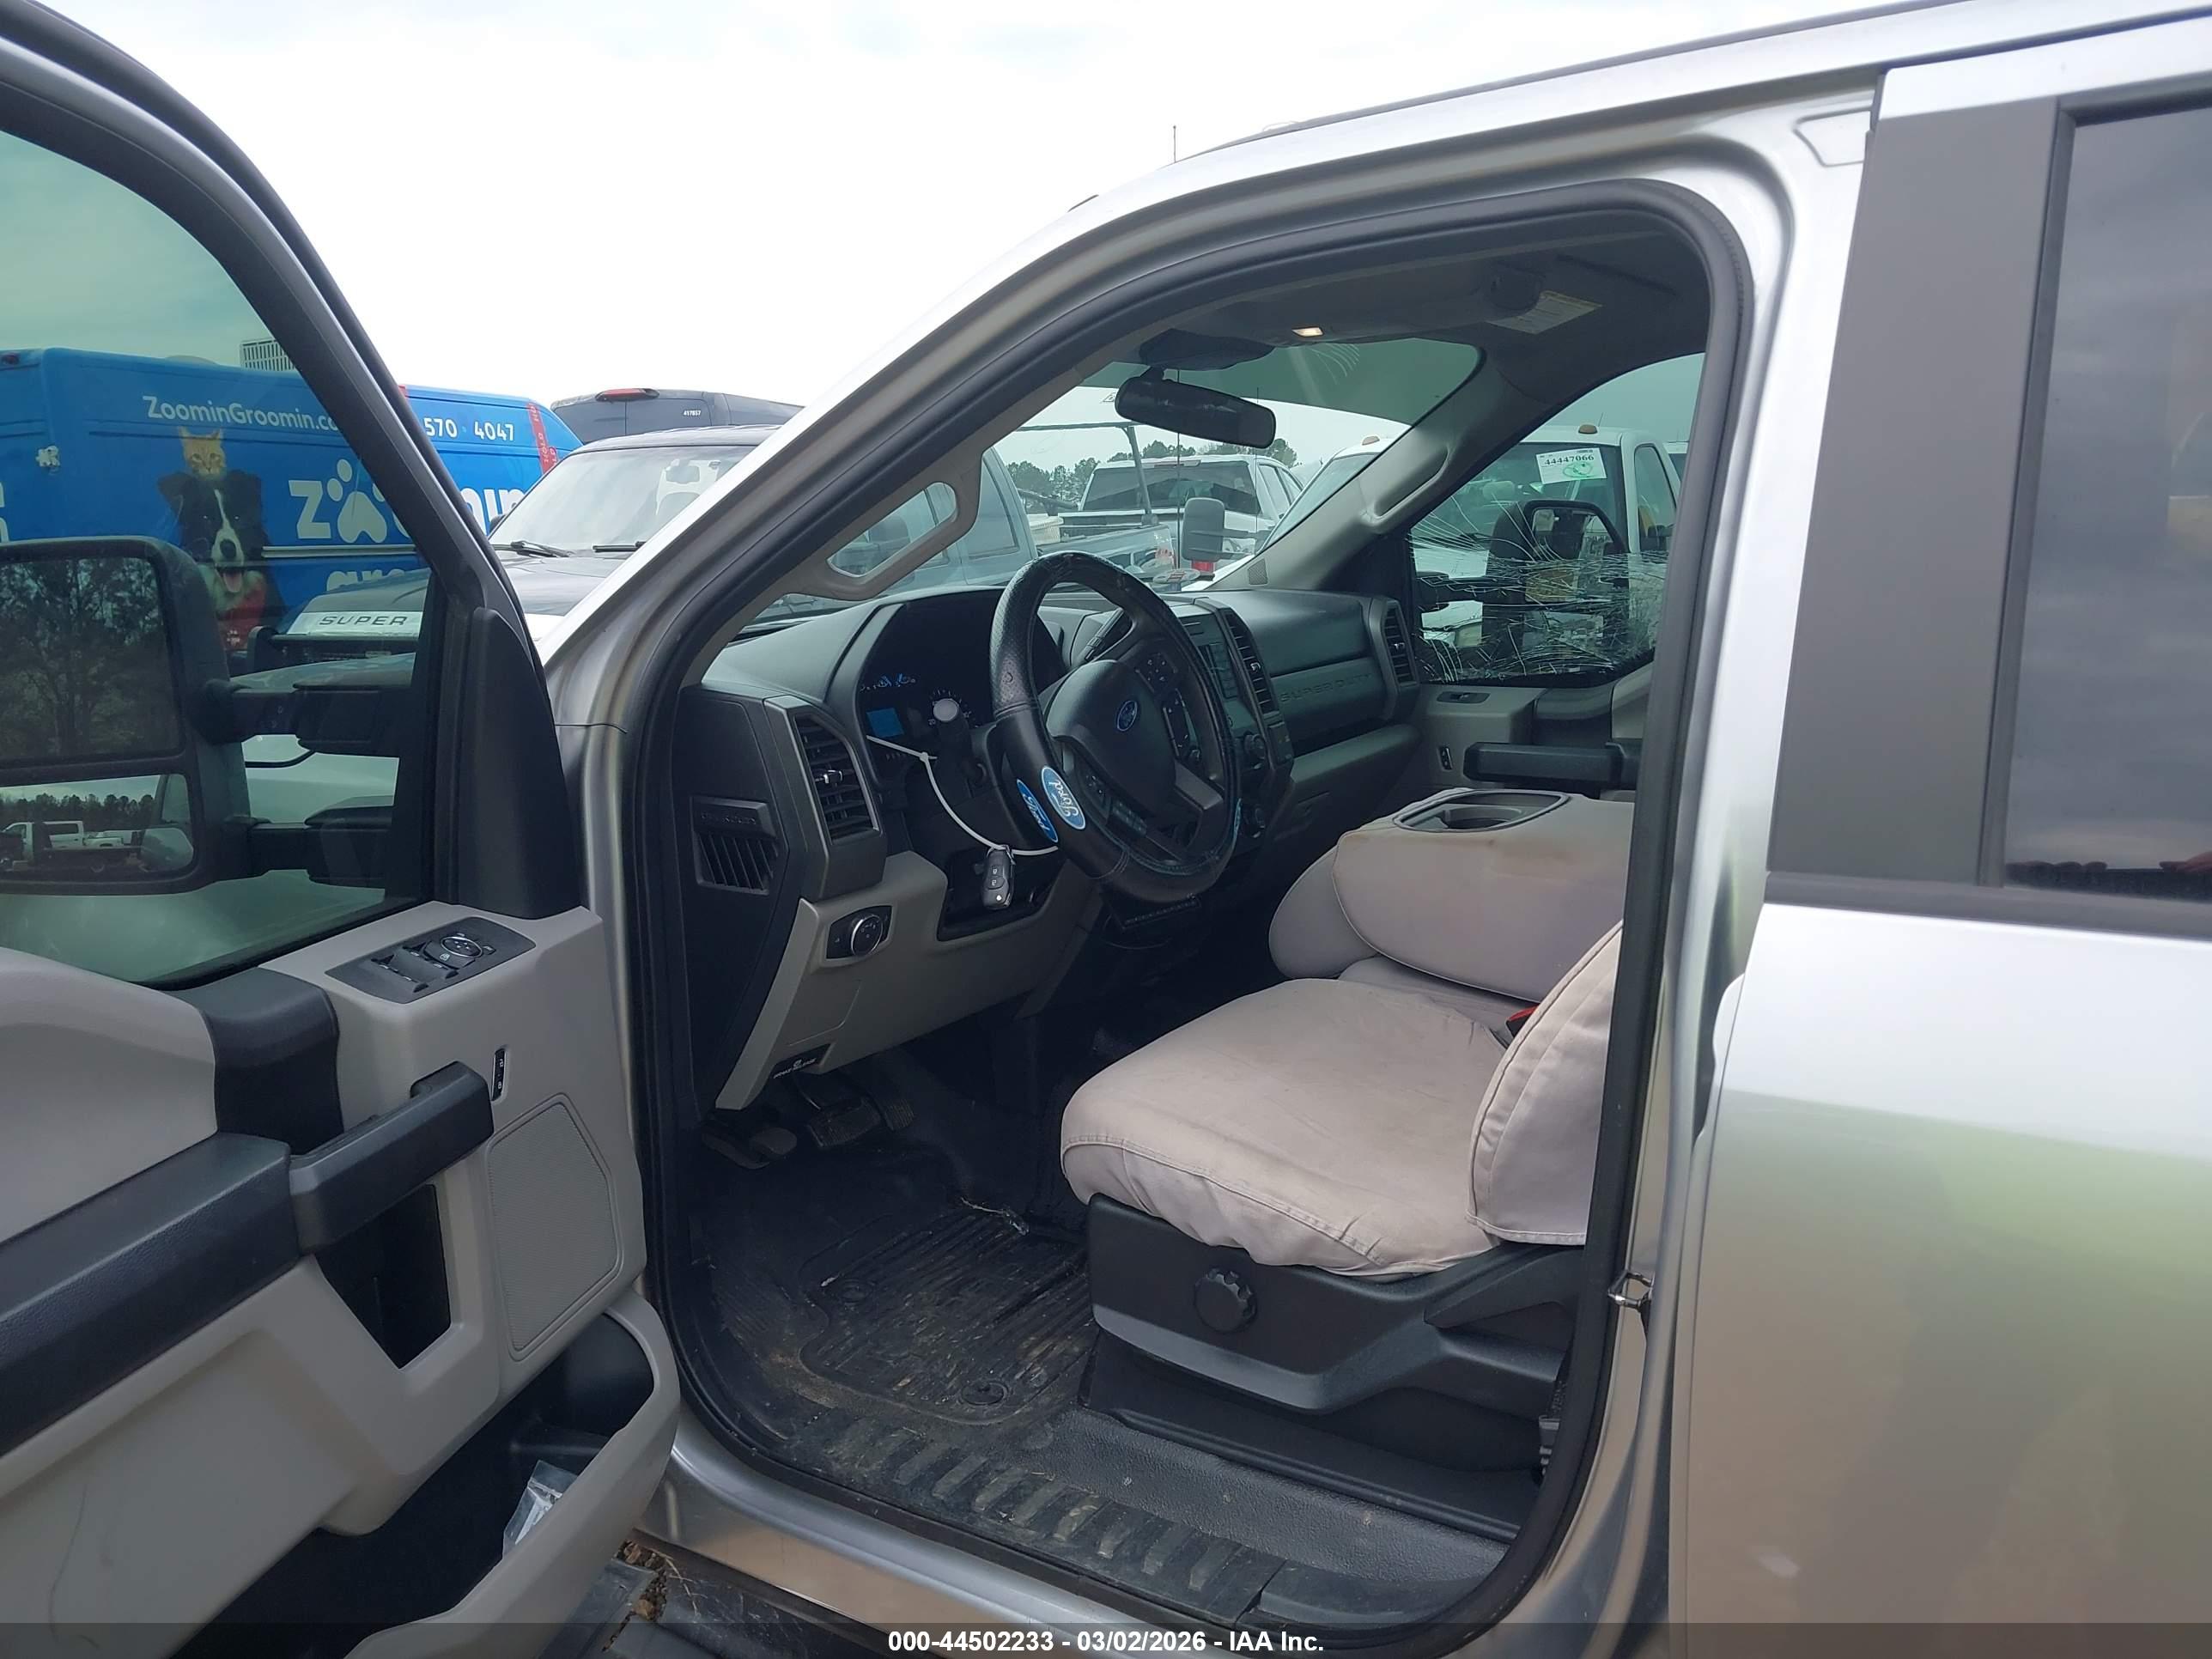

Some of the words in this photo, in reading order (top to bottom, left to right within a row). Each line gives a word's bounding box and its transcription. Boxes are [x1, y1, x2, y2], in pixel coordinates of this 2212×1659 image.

[422, 417, 458, 438] 570
[474, 421, 514, 441] 4047
[1544, 453, 1595, 465] 44447066
[319, 616, 408, 626] SUPER
